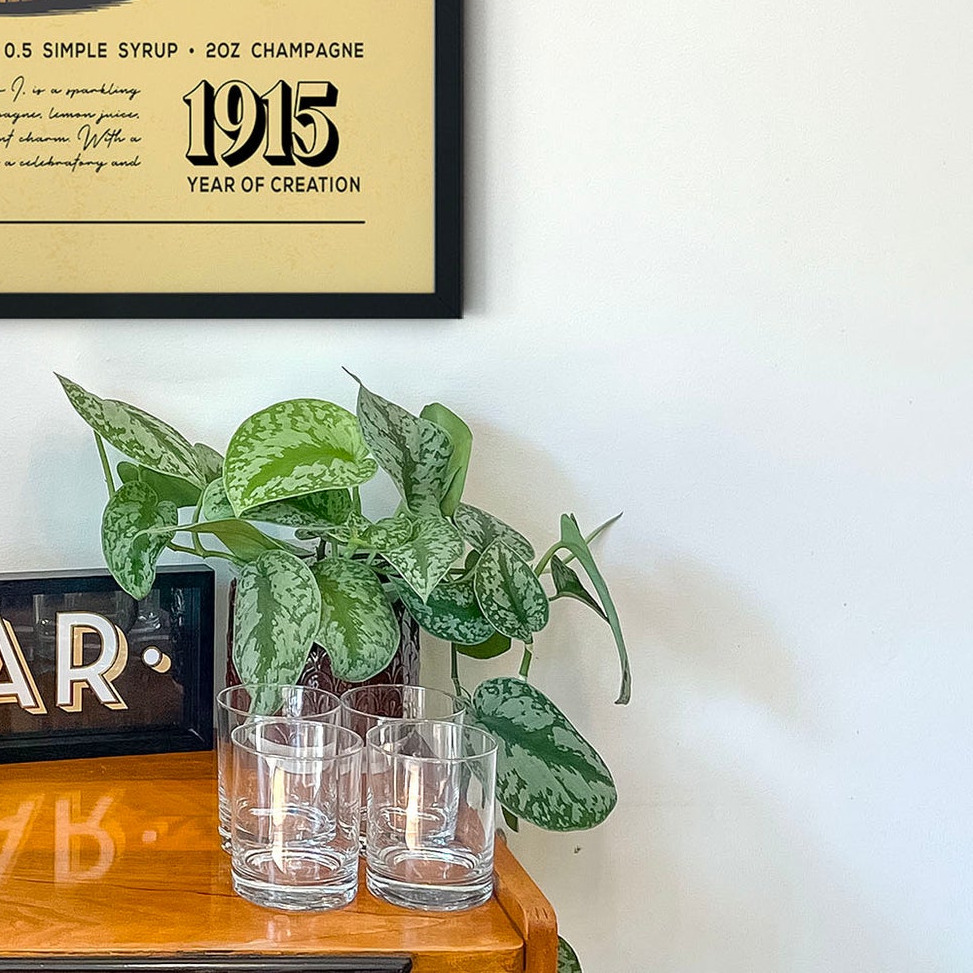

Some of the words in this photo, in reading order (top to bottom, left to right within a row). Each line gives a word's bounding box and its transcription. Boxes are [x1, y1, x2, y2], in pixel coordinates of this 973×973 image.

[4, 42, 32, 59] 0.5
[42, 42, 107, 59] SIMPLE
[118, 42, 178, 59] SYRUP
[251, 42, 364, 59] CHAMPAGNE
[32, 85, 45, 96] is
[50, 87, 62, 96] a
[65, 83, 141, 101] sparkling
[48, 107, 96, 119] lemon
[182, 79, 340, 168] 1915
[77, 123, 126, 151] With
[4, 160, 16, 168] a
[19, 153, 107, 173] celebratory
[111, 155, 141, 168] and
[186, 176, 236, 193] YEAR
[241, 176, 265, 193] OF
[270, 176, 361, 193] CREATION
